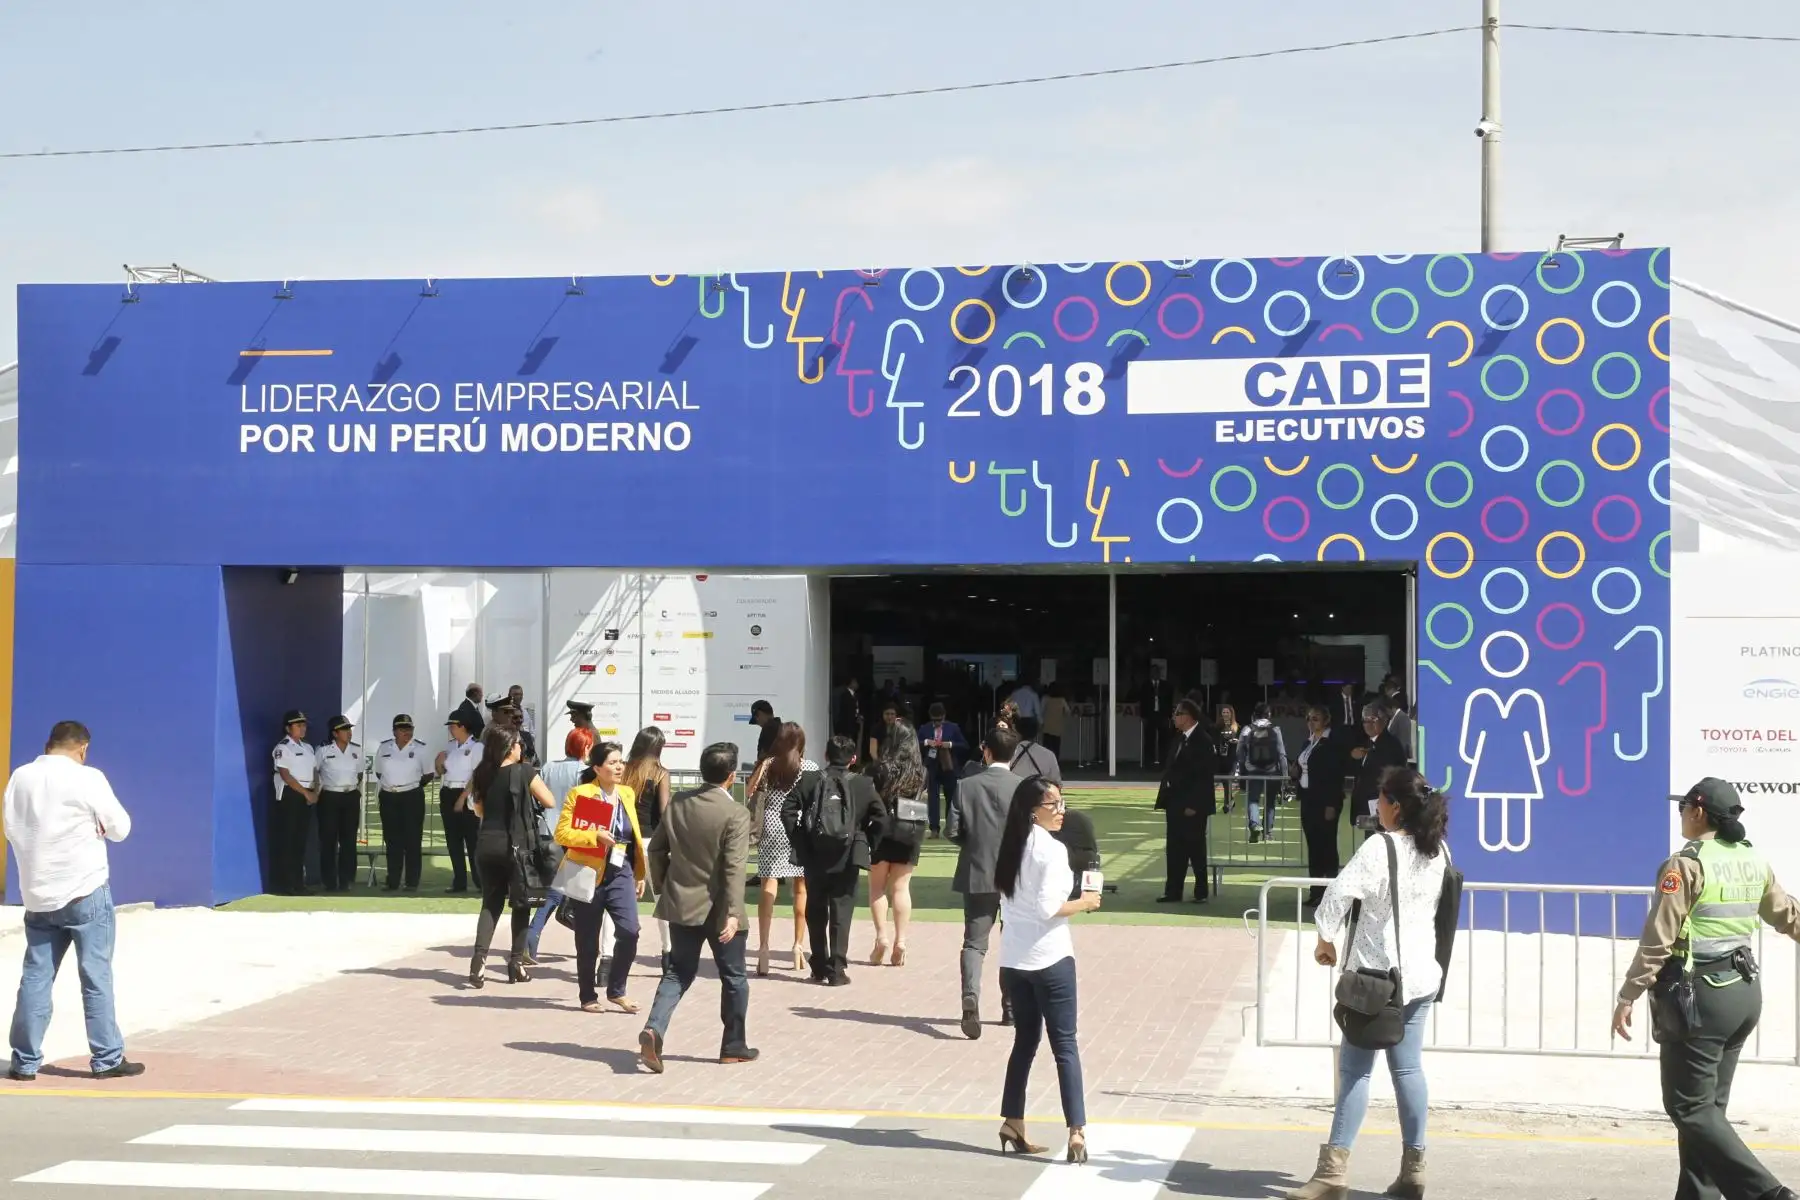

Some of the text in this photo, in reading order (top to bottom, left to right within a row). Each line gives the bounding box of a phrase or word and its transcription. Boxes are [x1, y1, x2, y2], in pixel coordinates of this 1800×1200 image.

[240, 380, 700, 413] LIDERAZGO EMPRESARIAL
[947, 359, 1425, 417] 2018 CADE
[240, 417, 692, 453] POR UN PERÚ MODERNO
[1215, 415, 1426, 443] EJECUTIVOS
[1700, 729, 1798, 741] TOYOTA DEL
[574, 818, 607, 832] IPAE
